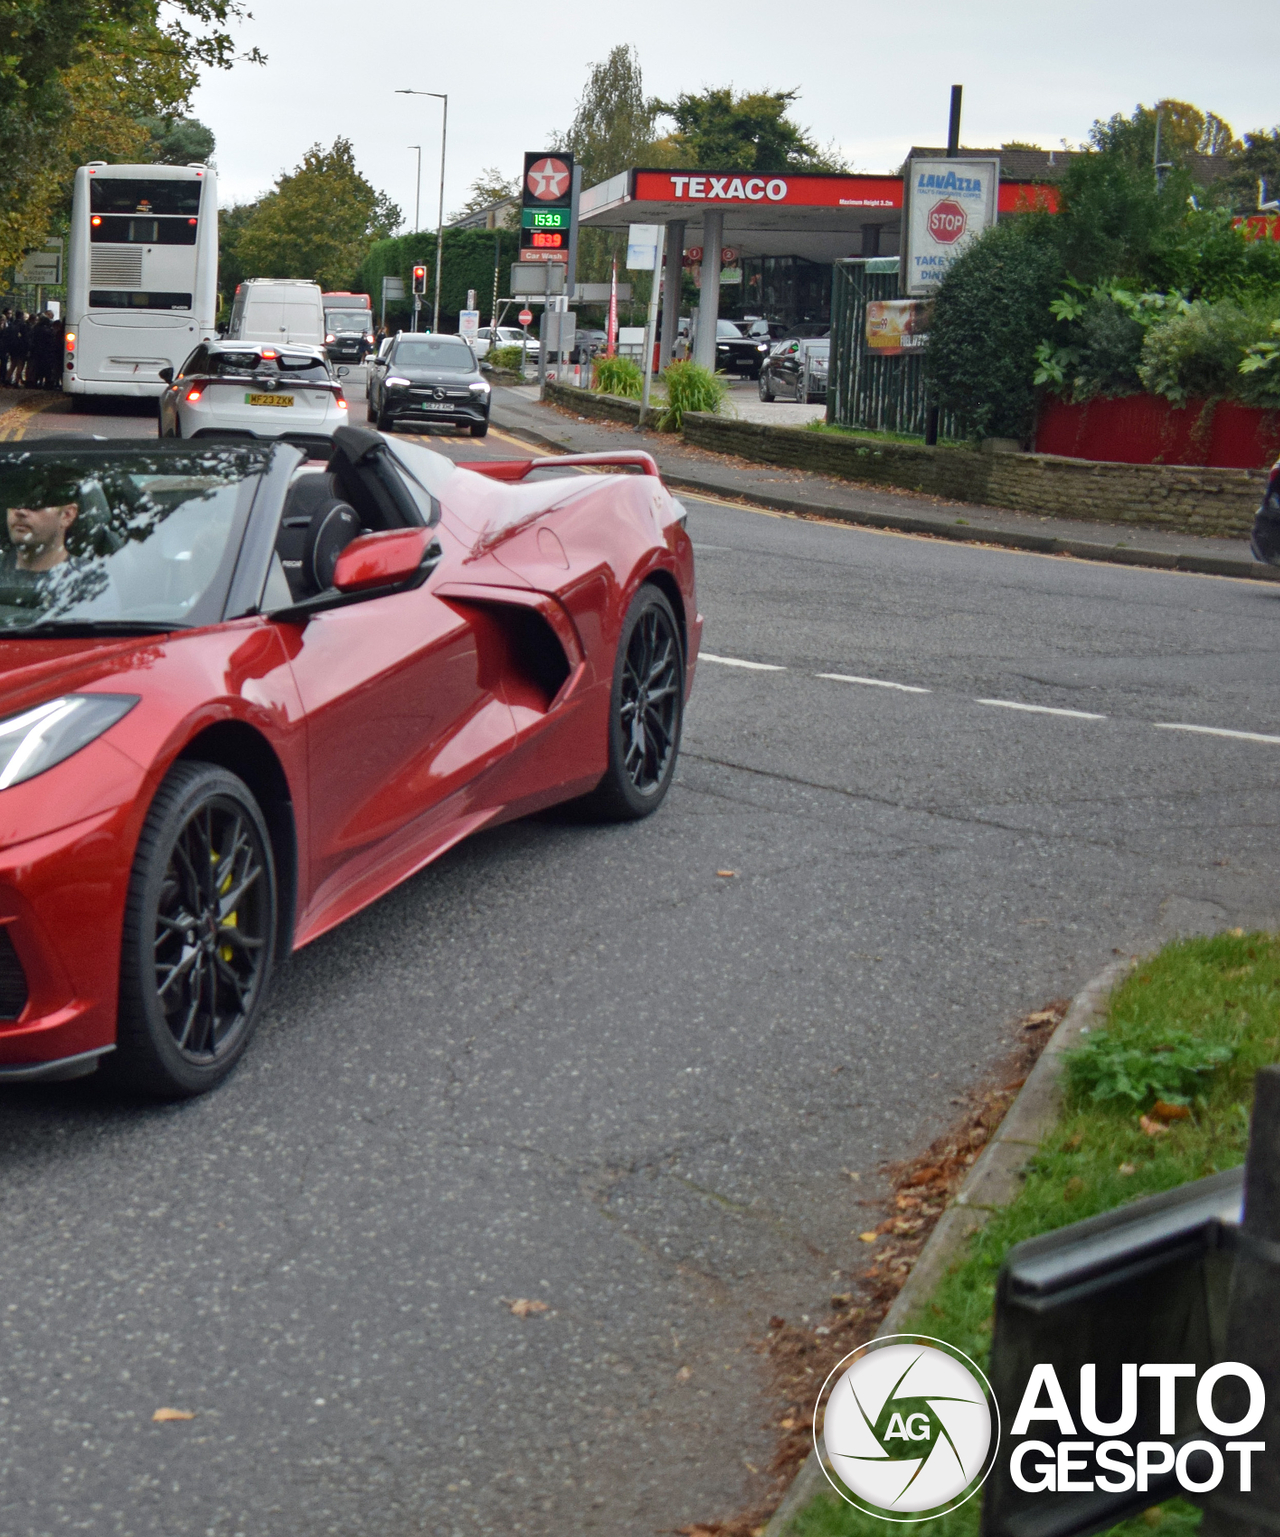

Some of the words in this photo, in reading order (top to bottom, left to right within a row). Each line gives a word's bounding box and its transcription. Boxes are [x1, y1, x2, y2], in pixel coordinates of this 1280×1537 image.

[918, 171, 982, 192] LAVAZZA
[670, 176, 787, 201] TEXACO
[534, 214, 561, 226] 153.9
[931, 213, 963, 231] STOP
[532, 233, 562, 248] 163.9
[526, 252, 540, 260] Car
[541, 252, 562, 260] Wash
[915, 256, 944, 266] TAKE
[251, 395, 274, 404] MF23
[276, 396, 294, 405] ZKK
